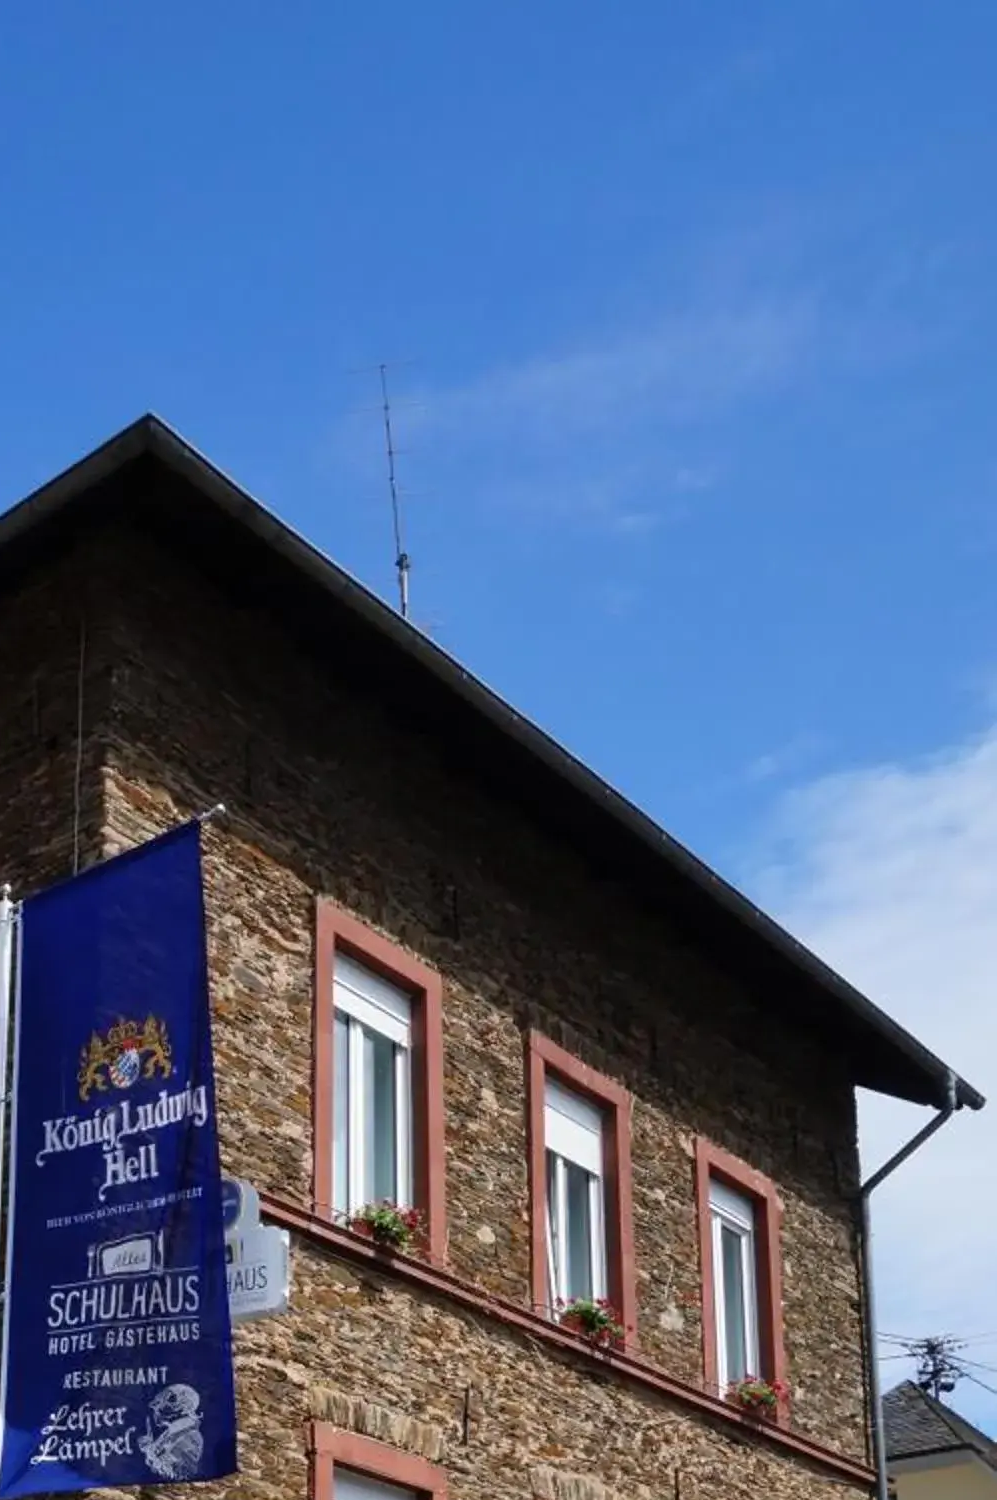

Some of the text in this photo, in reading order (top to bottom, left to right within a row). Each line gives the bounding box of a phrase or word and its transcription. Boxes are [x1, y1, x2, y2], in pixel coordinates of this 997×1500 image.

[36, 1081, 209, 1167] König Ludwig
[99, 1144, 159, 1201] Hell
[47, 1276, 200, 1326] SCHULHAUS
[48, 1322, 200, 1355] HOTEL GÄSTEHAUS
[63, 1367, 169, 1389] RESTAURANT
[41, 1400, 128, 1436] Lehrer
[30, 1427, 136, 1466] Lämpel
